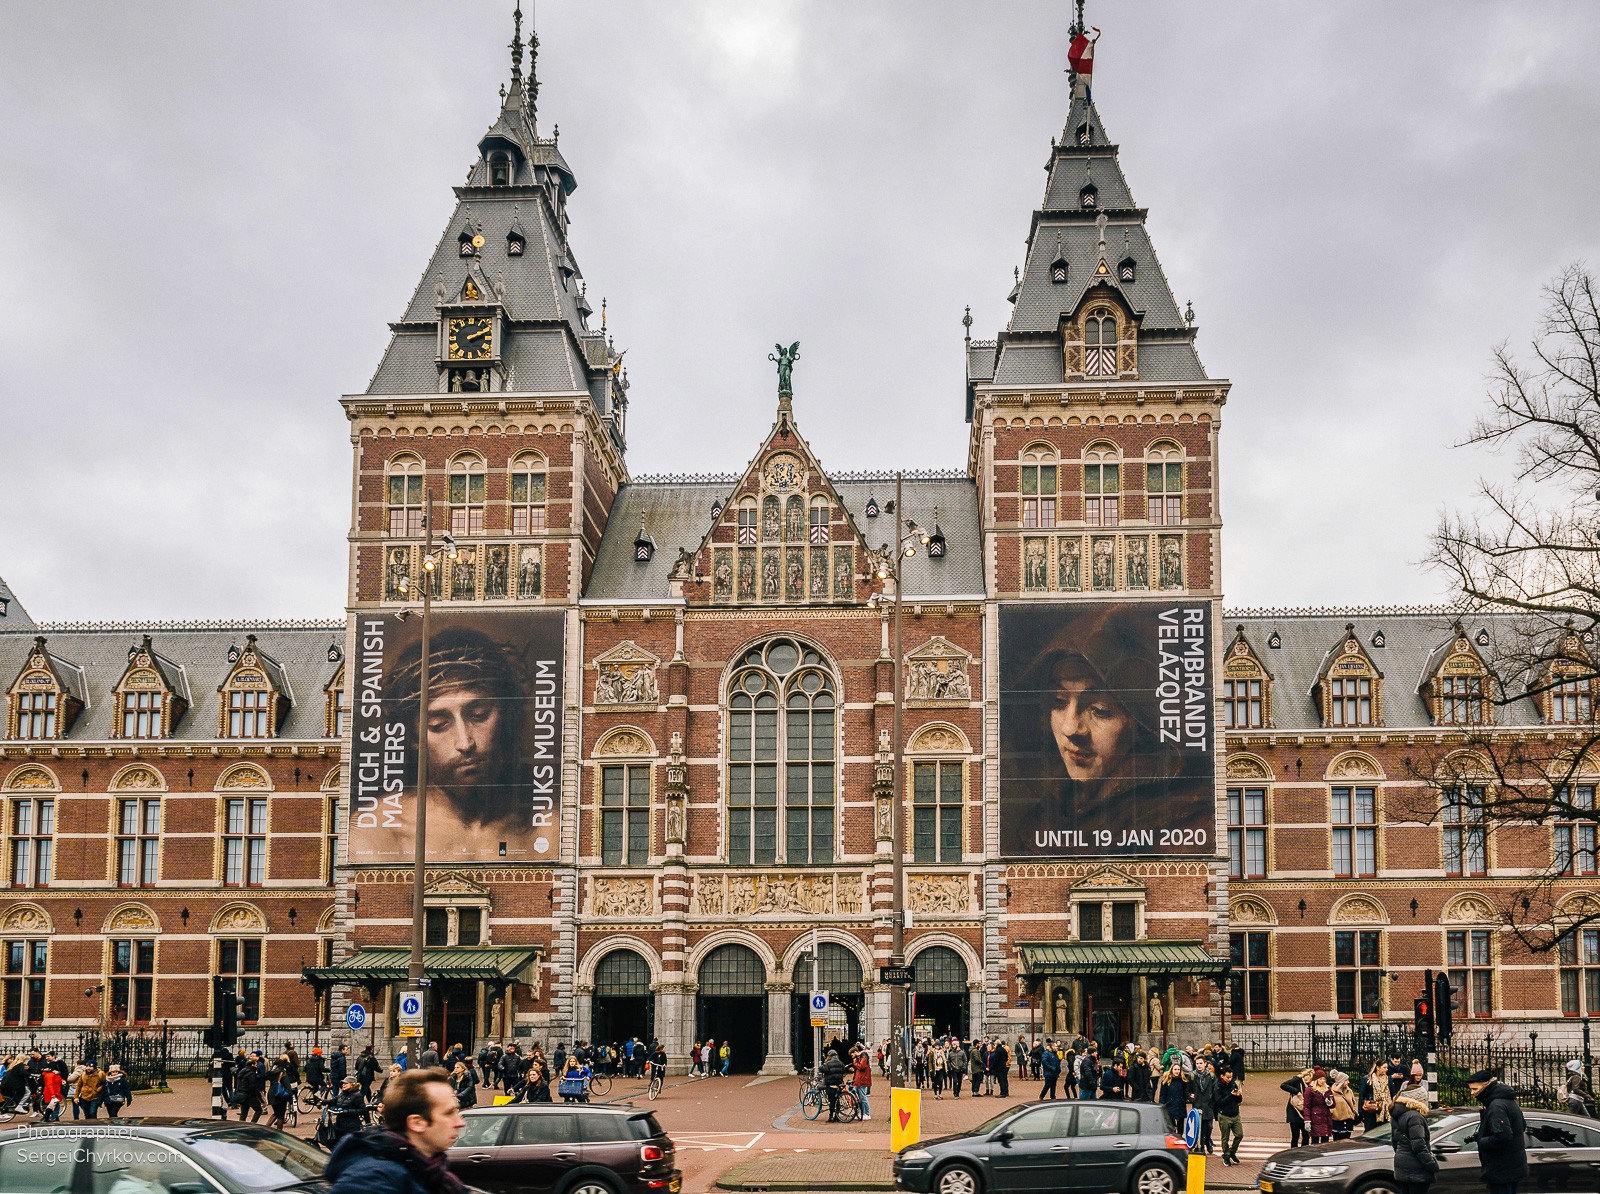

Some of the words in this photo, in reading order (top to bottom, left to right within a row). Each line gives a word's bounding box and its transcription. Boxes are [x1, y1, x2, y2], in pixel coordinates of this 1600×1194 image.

[361, 620, 384, 718] SPANISH
[533, 660, 556, 760] MUSEUM
[1156, 607, 1182, 743] VELÁZQUEZ
[1183, 608, 1206, 752] REMBRANDT
[360, 725, 381, 744] &
[382, 722, 405, 828] MASTERS
[357, 752, 380, 828] DUTCH
[532, 765, 554, 827] RIJKS
[1035, 830, 1088, 847] UNTIL
[1092, 829, 1112, 847] 19
[1117, 829, 1153, 847] JAN
[1159, 828, 1207, 846] 2020
